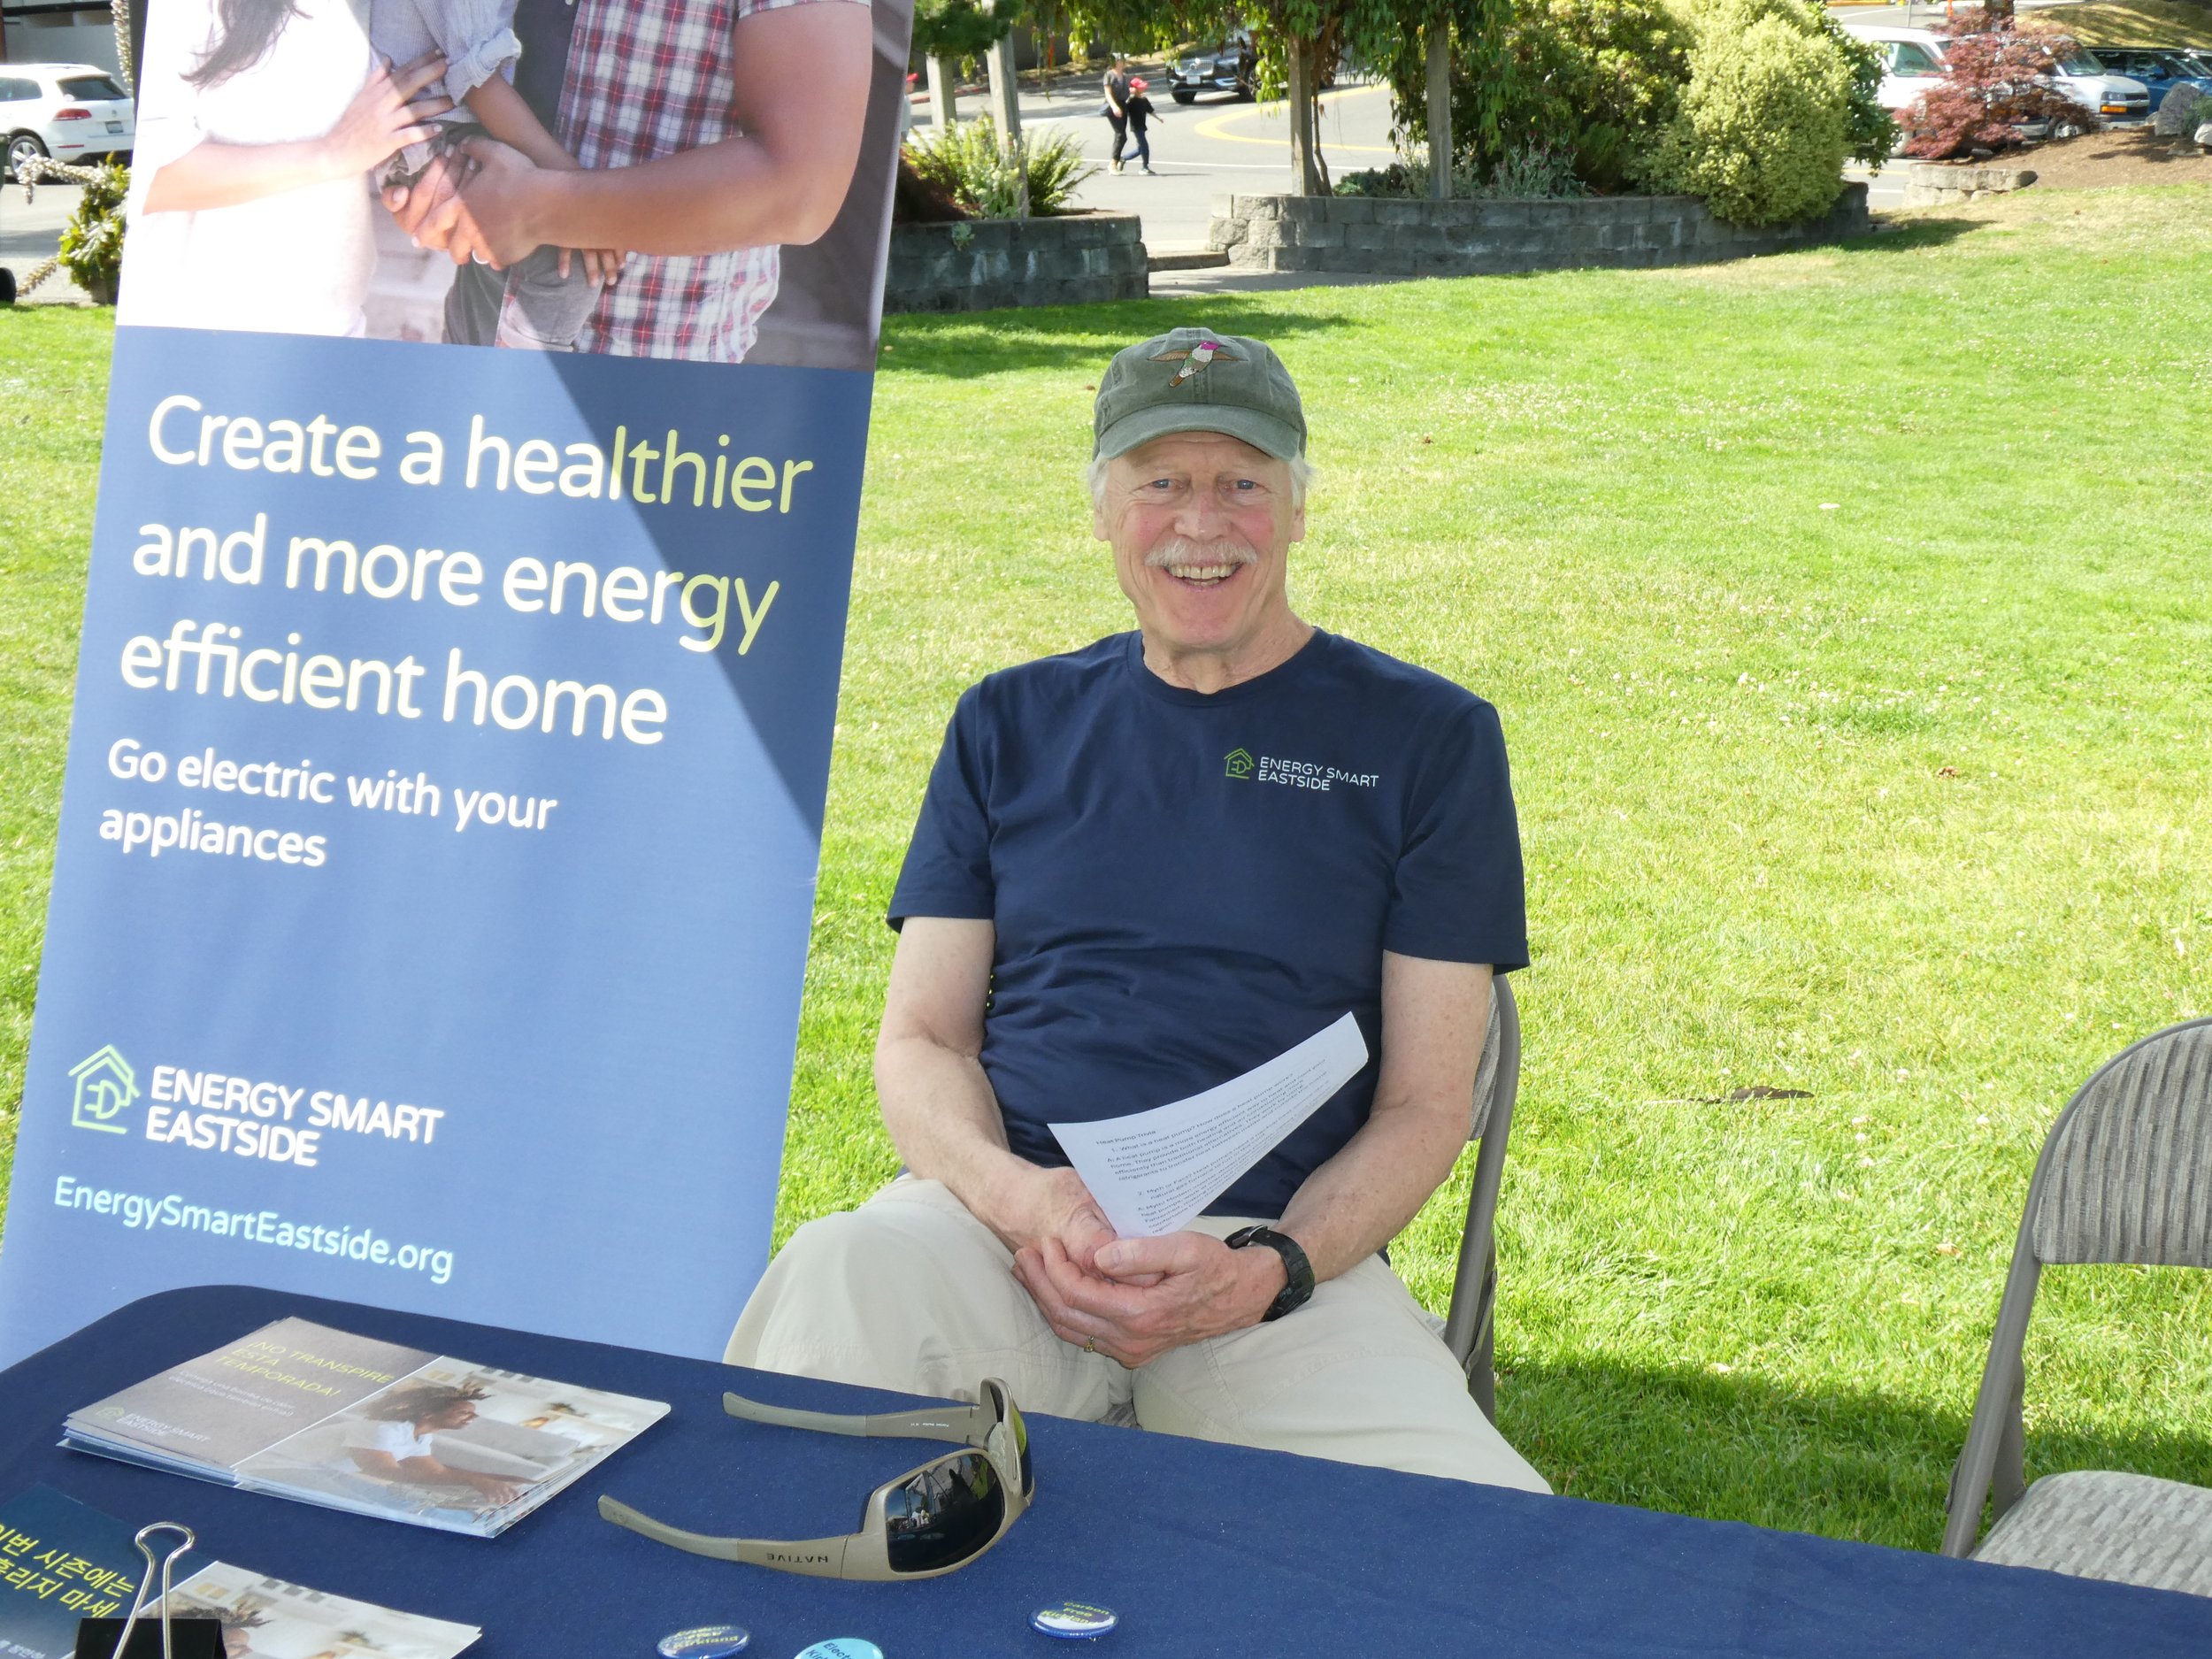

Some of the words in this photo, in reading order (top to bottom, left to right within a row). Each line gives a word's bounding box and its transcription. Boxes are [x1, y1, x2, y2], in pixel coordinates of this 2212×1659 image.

[149, 395, 380, 480] Create
[399, 428, 443, 486] a
[465, 414, 813, 514] healthier
[133, 513, 267, 586] and
[286, 534, 482, 606] more
[503, 554, 780, 656] energy
[121, 618, 425, 720] efficient
[443, 648, 668, 746] home
[108, 737, 167, 782] Go
[177, 747, 335, 804] electric
[347, 767, 440, 818] with
[453, 779, 557, 833] your
[1258, 770, 1331, 791] EASTSIDE
[1260, 757, 1324, 776] ENERGY
[1325, 767, 1379, 787] SMART
[99, 803, 326, 868] appliances
[150, 1065, 304, 1120] ENERGY
[308, 1090, 445, 1144] SMART
[146, 1105, 321, 1167] EASTSIDE
[54, 1176, 454, 1285] EnergySmartEastside.org
[215, 1356, 342, 1396] TEMPORADA!
[231, 1348, 280, 1367] ESTA
[289, 1351, 395, 1384] TRANSPIRE
[33, 1549, 135, 1598] 시즌에는
[766, 1553, 828, 1563] NATIVE
[823, 1642, 852, 1659] Elect
